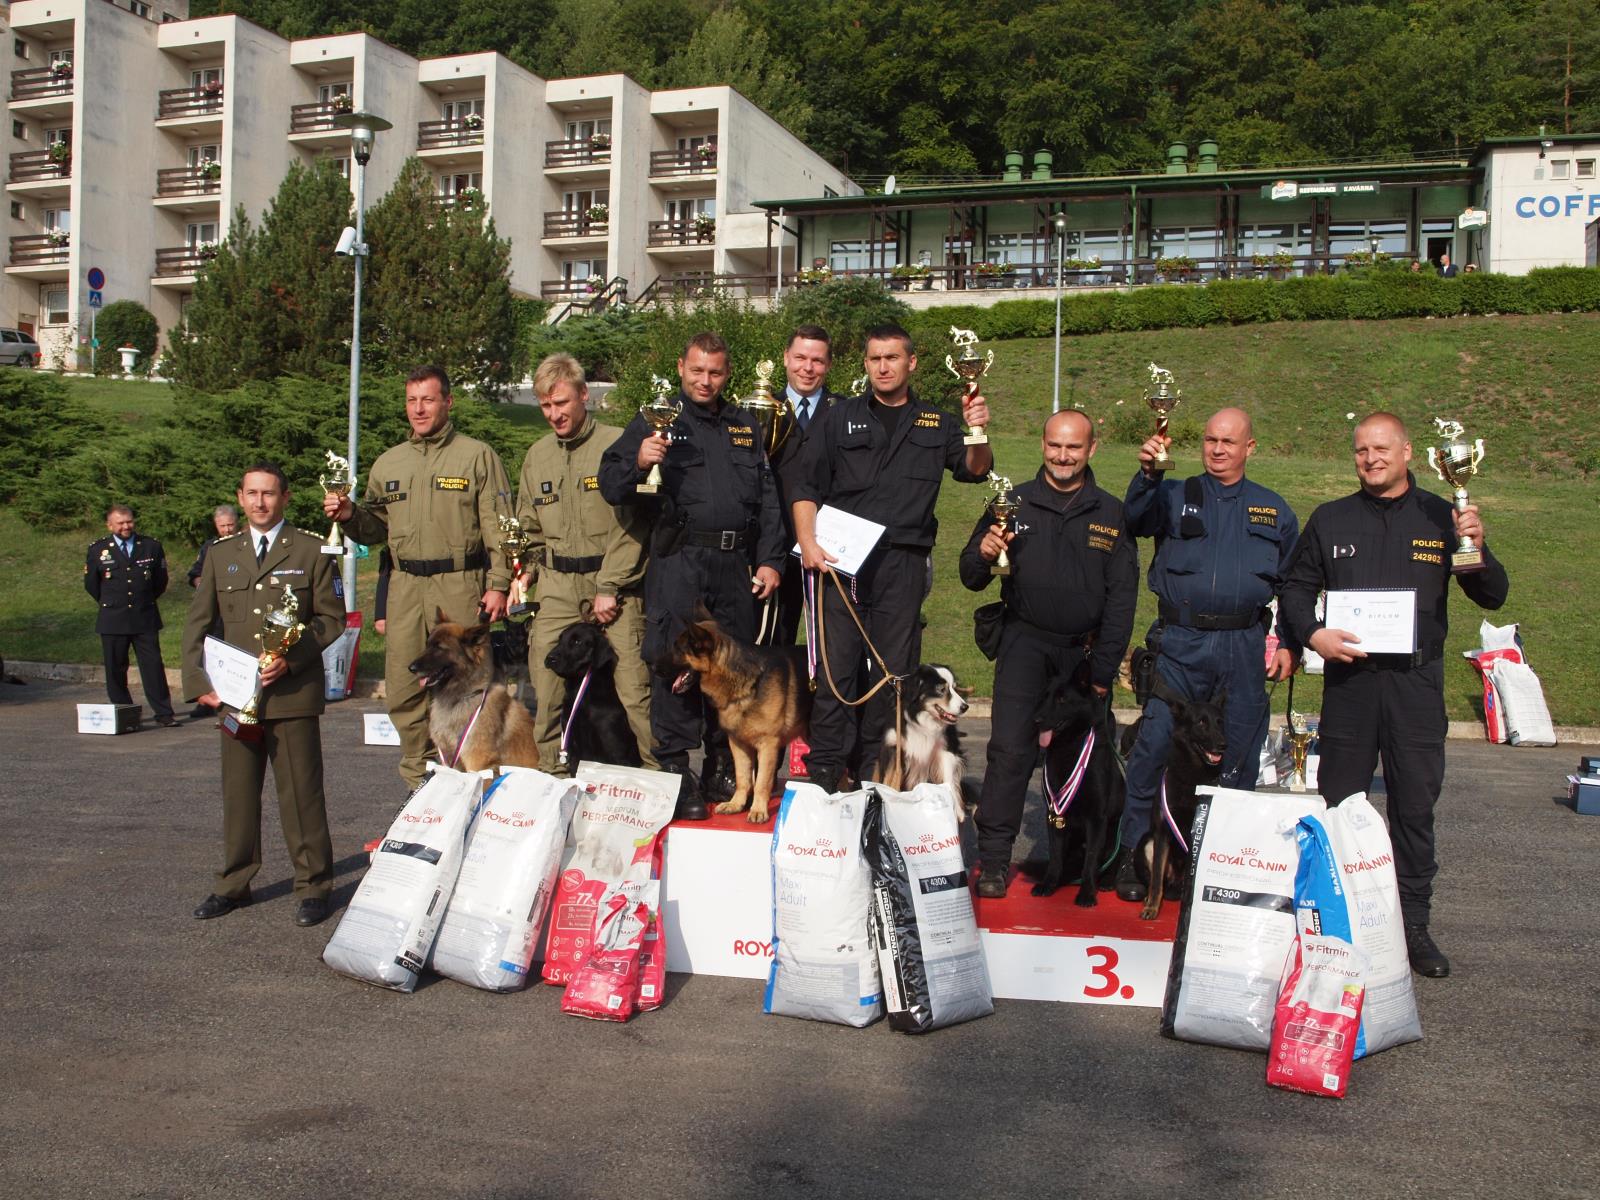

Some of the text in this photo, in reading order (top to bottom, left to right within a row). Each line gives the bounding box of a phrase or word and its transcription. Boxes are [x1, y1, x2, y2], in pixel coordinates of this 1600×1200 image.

[1515, 194, 1600, 219] COFF
[1248, 506, 1277, 515] POLICIE
[1089, 523, 1120, 537] POLICIE
[1412, 539, 1445, 549] POLICIE
[599, 783, 646, 801] Fitmin
[787, 843, 818, 857] ROYAL
[903, 844, 931, 856] ROYAL
[1209, 852, 1288, 872] ROYAL CANIN
[780, 890, 808, 907] Adult
[1216, 889, 1240, 899] 4300
[1300, 899, 1316, 907] AXI
[1360, 913, 1388, 929] Adult
[1316, 944, 1349, 958] Fitmin
[547, 968, 561, 981] 15
[1083, 945, 1135, 1000] 3.
